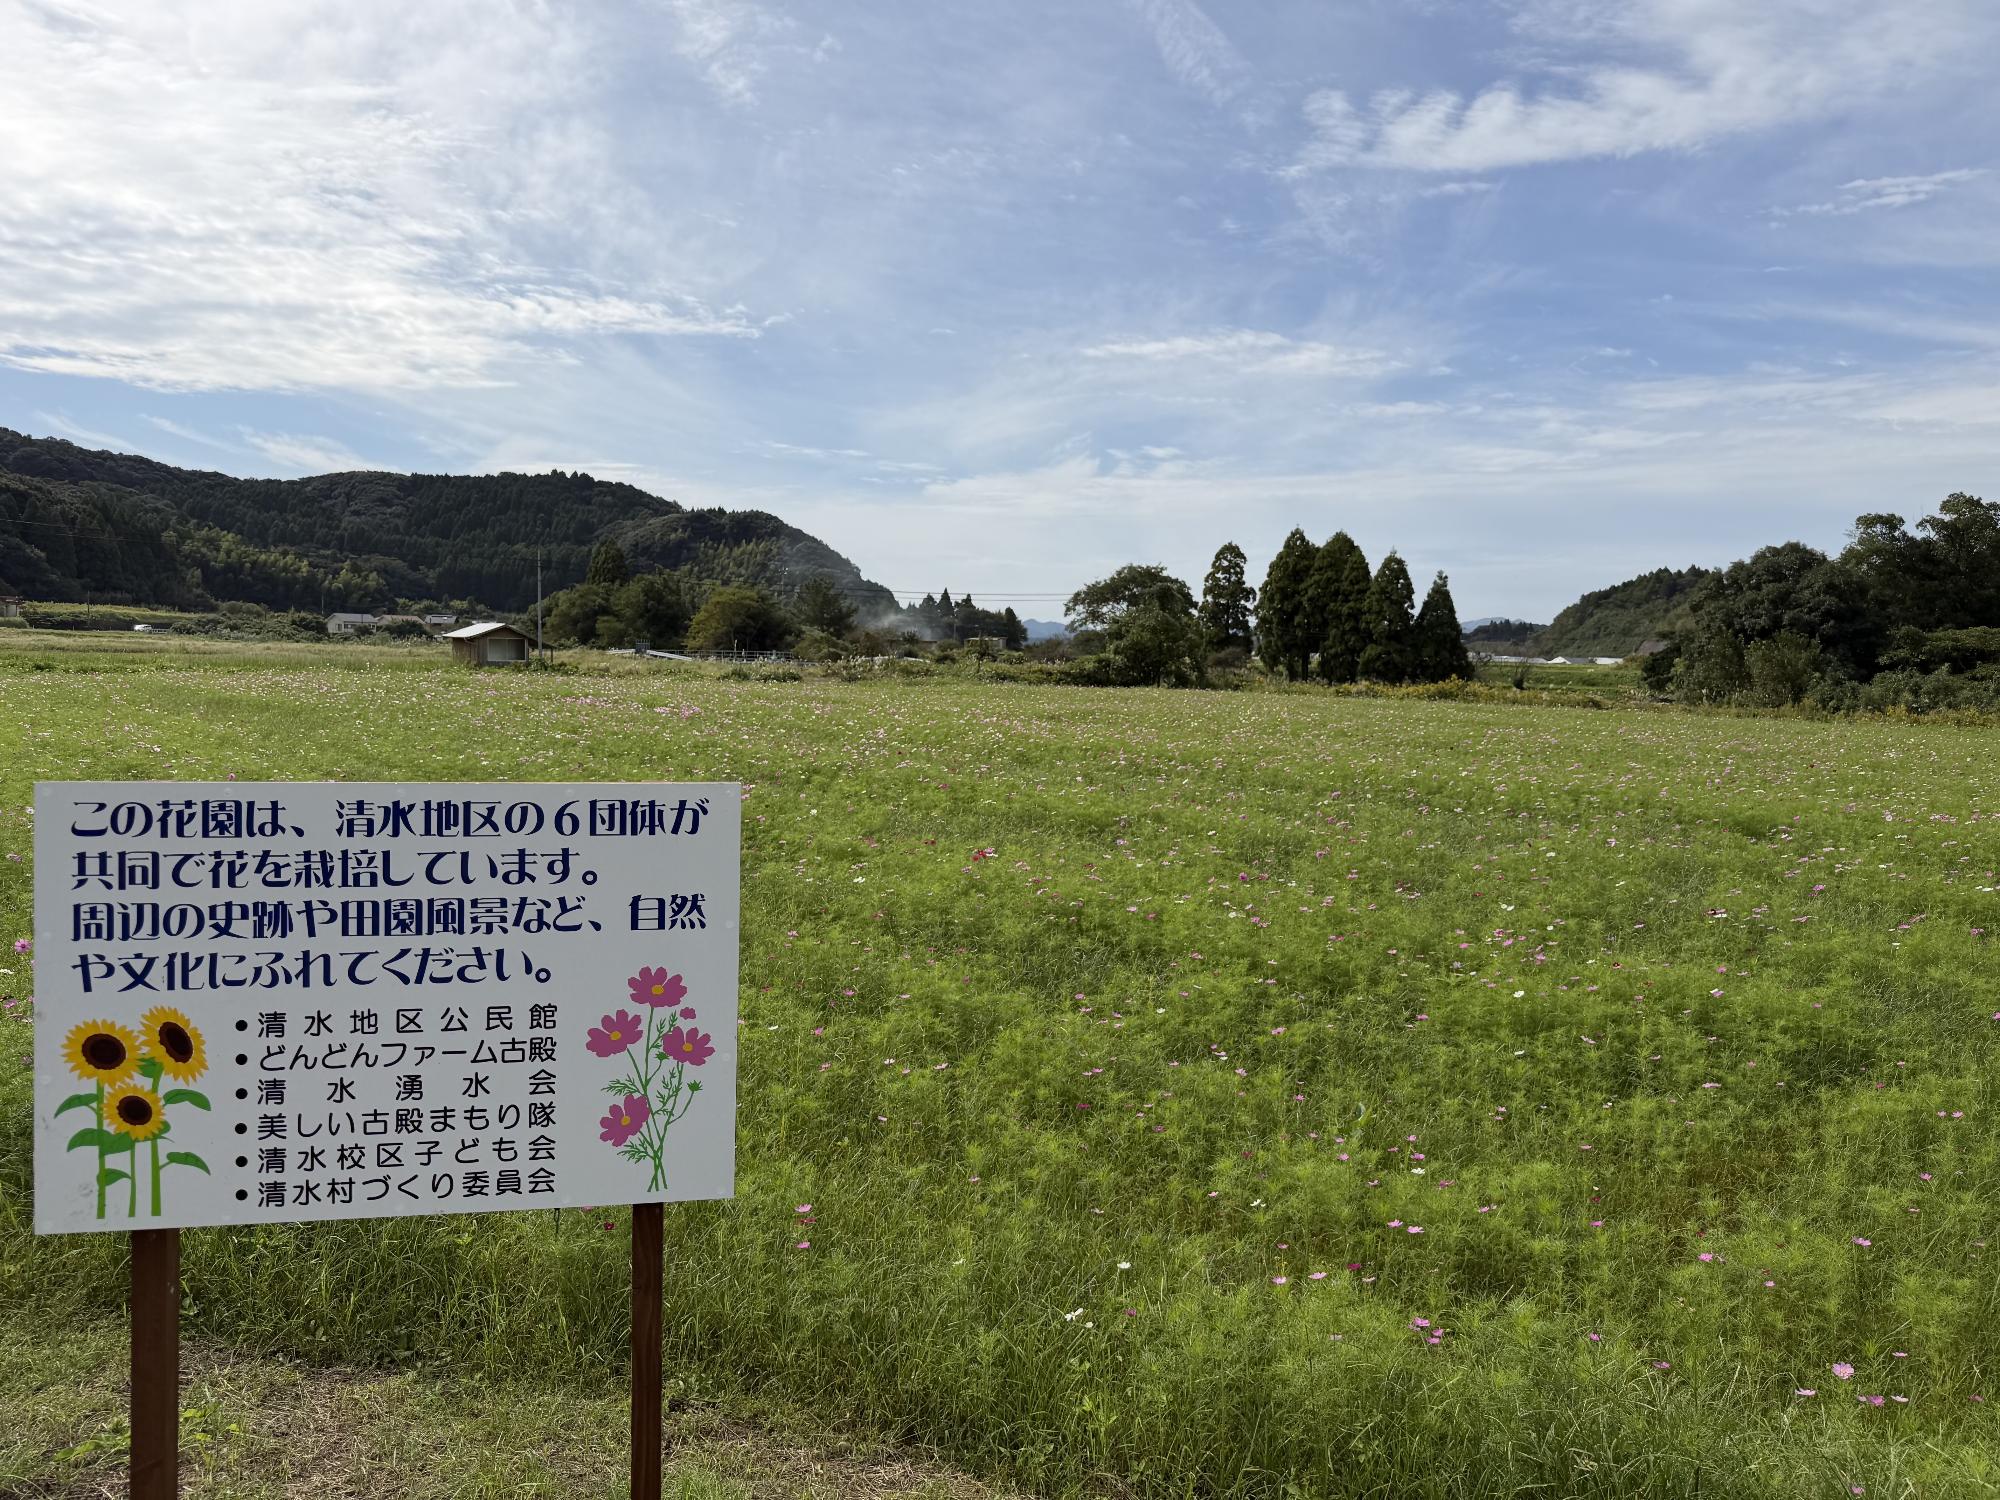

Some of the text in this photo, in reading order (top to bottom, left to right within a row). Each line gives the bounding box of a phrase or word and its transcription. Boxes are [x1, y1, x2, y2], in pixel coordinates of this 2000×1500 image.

[71, 847, 598, 891] 共同で花を栽培しています。
[70, 946, 552, 993] や文化にふれてください。
[259, 1036, 558, 1072] どんどんファーム古殿
[257, 1100, 557, 1141] 美しい古殿まもり隊
[257, 1167, 556, 1208] 清水村づくり委員会
